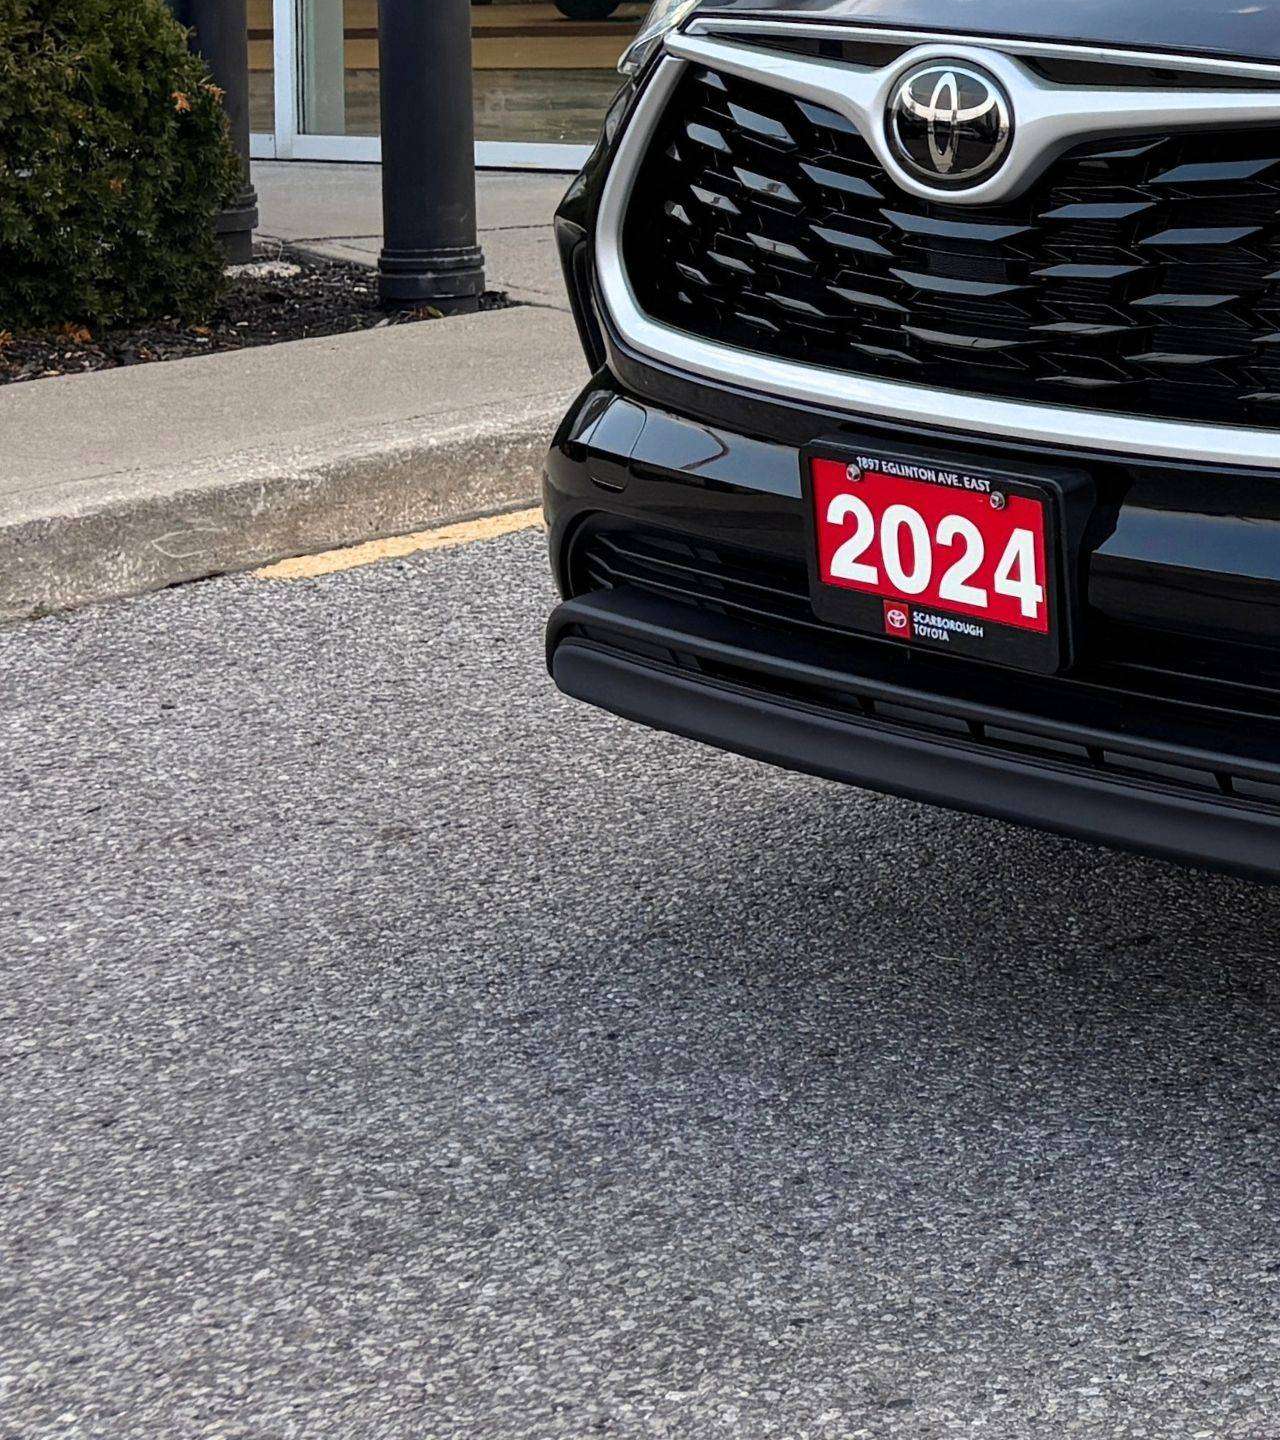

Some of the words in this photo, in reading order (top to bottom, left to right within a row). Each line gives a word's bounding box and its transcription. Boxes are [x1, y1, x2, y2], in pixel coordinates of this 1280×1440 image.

[856, 456, 880, 471] 1897
[881, 460, 936, 482] EGLINTON
[937, 471, 962, 487] AVE.
[963, 476, 991, 493] EAST
[826, 493, 1044, 619] 2024
[912, 611, 984, 638] SCARBOROUGH
[912, 623, 950, 641] TOYOTA
